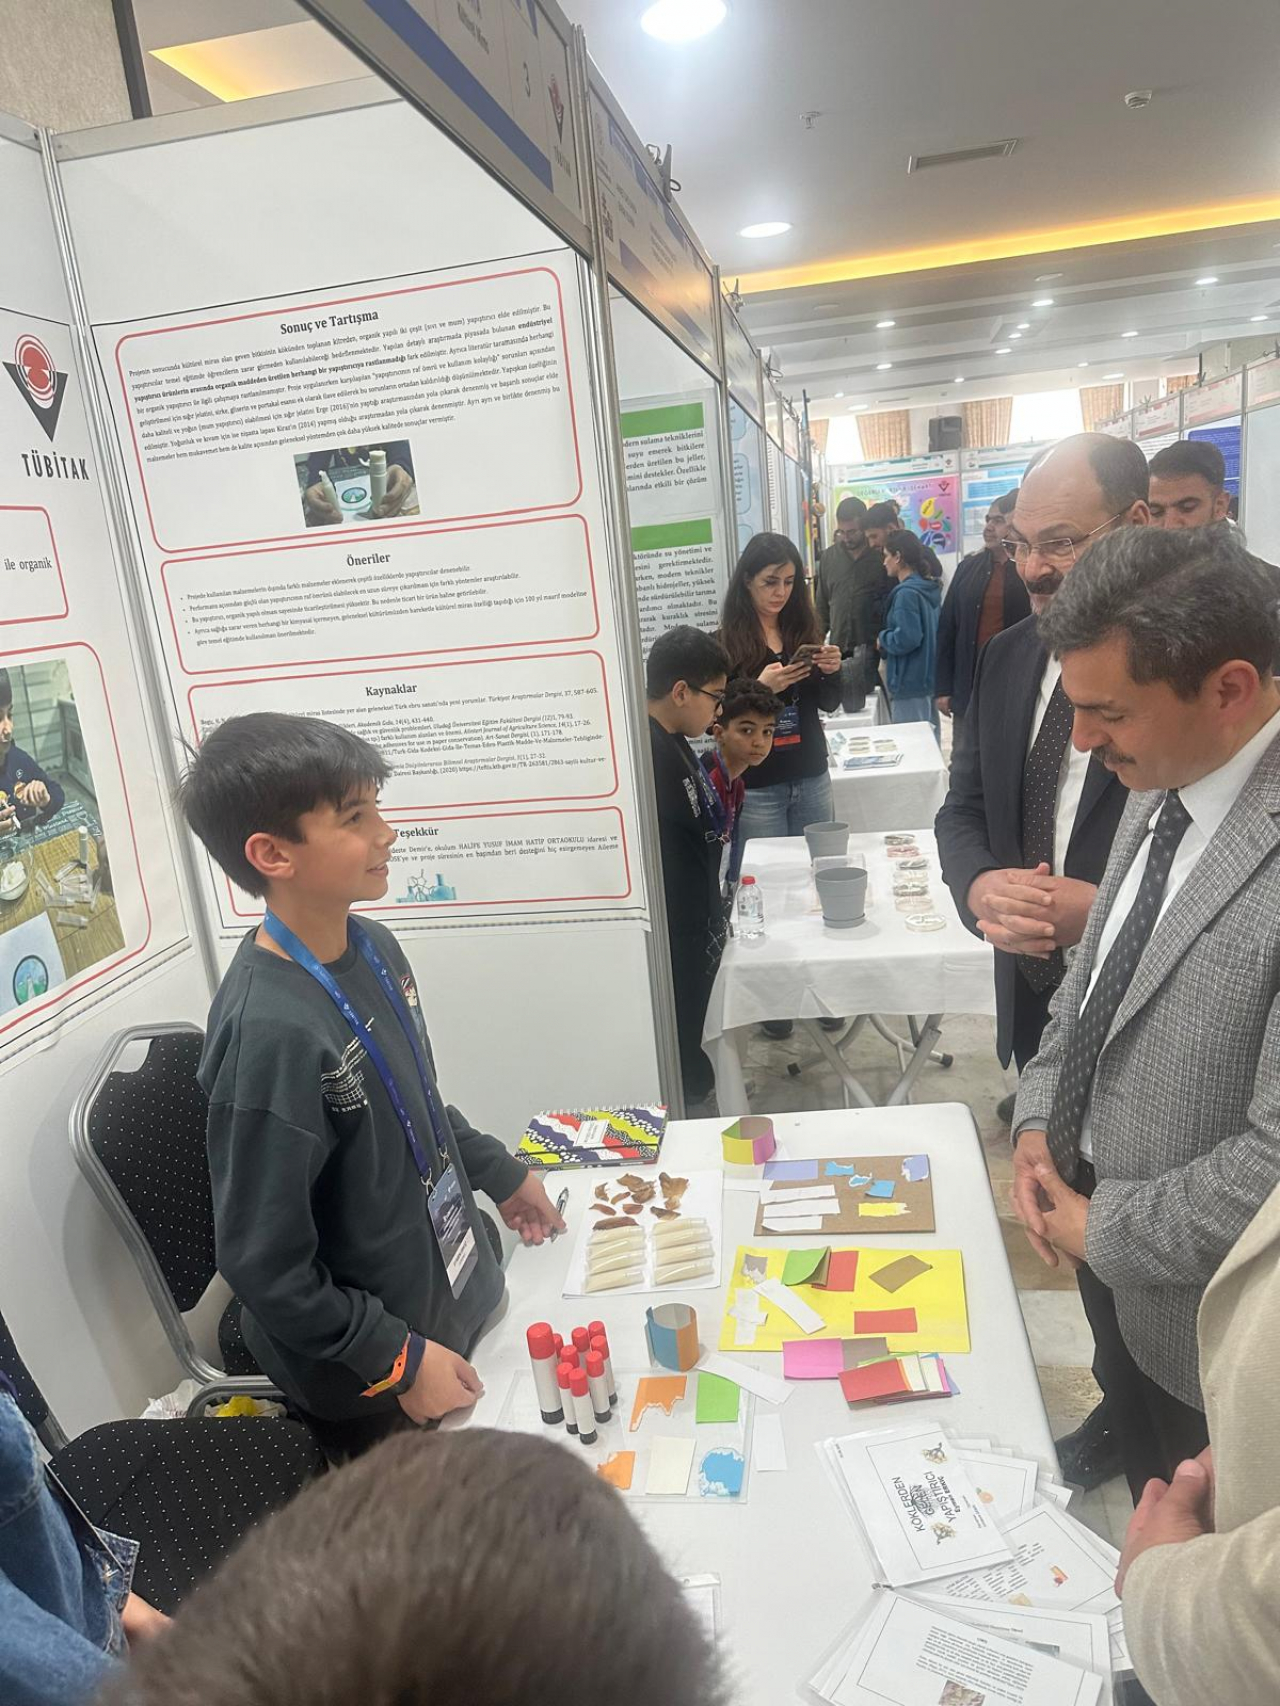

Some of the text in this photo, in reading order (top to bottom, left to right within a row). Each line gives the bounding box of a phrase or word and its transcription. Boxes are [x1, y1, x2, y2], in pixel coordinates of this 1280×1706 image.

[280, 310, 379, 335] Sonuç ve Tartışma
[21, 449, 90, 480] TÜBİTAK
[4, 557, 53, 571] ile organik
[346, 552, 391, 568] Öneriler
[365, 682, 418, 698] Kaynaklar
[393, 826, 439, 840] Teşekkür
[923, 1471, 957, 1522] YAPIŞTIRICI
